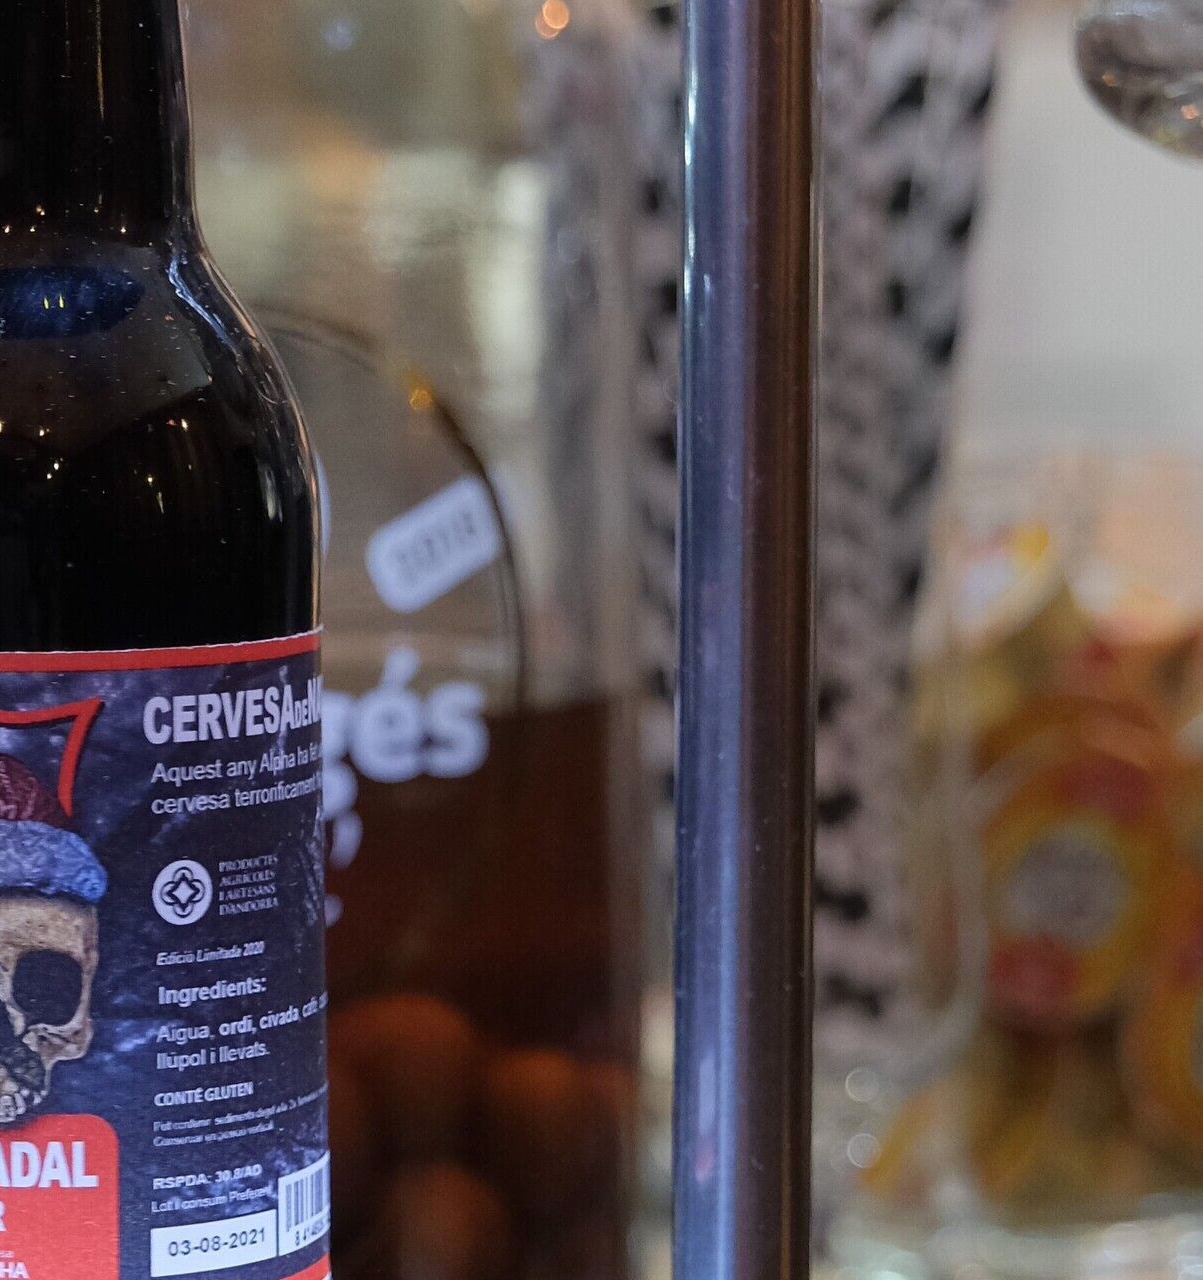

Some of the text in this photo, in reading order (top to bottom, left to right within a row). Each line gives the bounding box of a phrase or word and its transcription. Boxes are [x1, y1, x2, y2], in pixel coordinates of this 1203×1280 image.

[151, 759, 222, 787] Aquest
[227, 759, 256, 780] any
[259, 748, 296, 776] Alpha
[297, 746, 308, 766] ha
[151, 791, 231, 815] cervesa
[243, 941, 265, 956] 2020
[158, 977, 267, 1008] Ingredients:
[156, 1024, 215, 1045] Aigua,
[219, 1014, 257, 1035] ordi,
[210, 1047, 216, 1064] i
[219, 1041, 271, 1063] llevats.
[204, 1081, 254, 1102] GLUTEN
[168, 1227, 266, 1257] 03-08-2021
